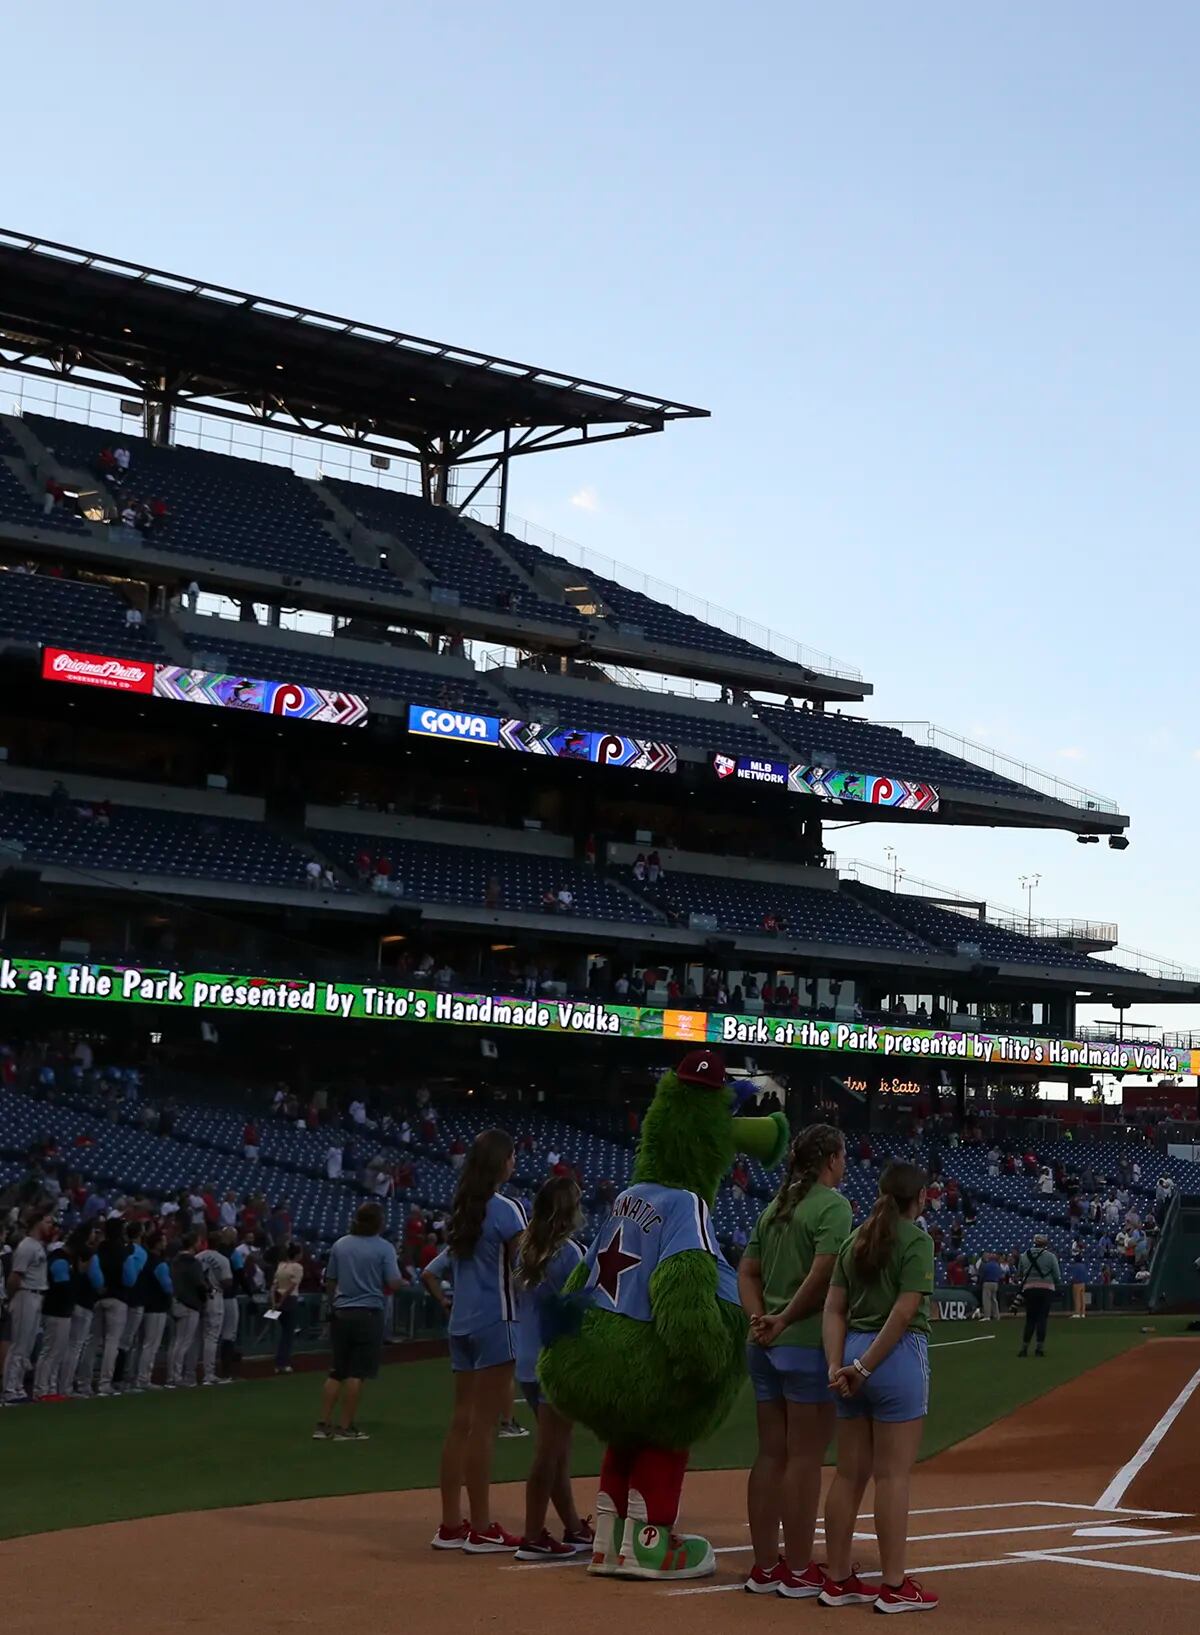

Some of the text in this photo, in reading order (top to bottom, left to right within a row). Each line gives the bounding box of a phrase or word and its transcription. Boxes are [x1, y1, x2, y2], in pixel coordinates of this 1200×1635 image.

[53, 653, 146, 682] Original Philly
[421, 710, 488, 737] GOYA
[737, 769, 785, 784] NETWORK
[750, 761, 772, 772] MLB
[27, 966, 57, 992] at
[68, 965, 112, 996] the
[123, 969, 183, 1001] Park
[193, 981, 316, 1011] presented
[326, 984, 354, 1018] by
[363, 987, 427, 1018] Tito's
[436, 993, 549, 1028] Handmade
[558, 1003, 621, 1032] Vodka
[723, 1015, 1178, 1071] Bark at the Park presented by Tito's Handmade Vodka
[891, 1078, 921, 1093] Eats
[643, 1527, 657, 1546] P
